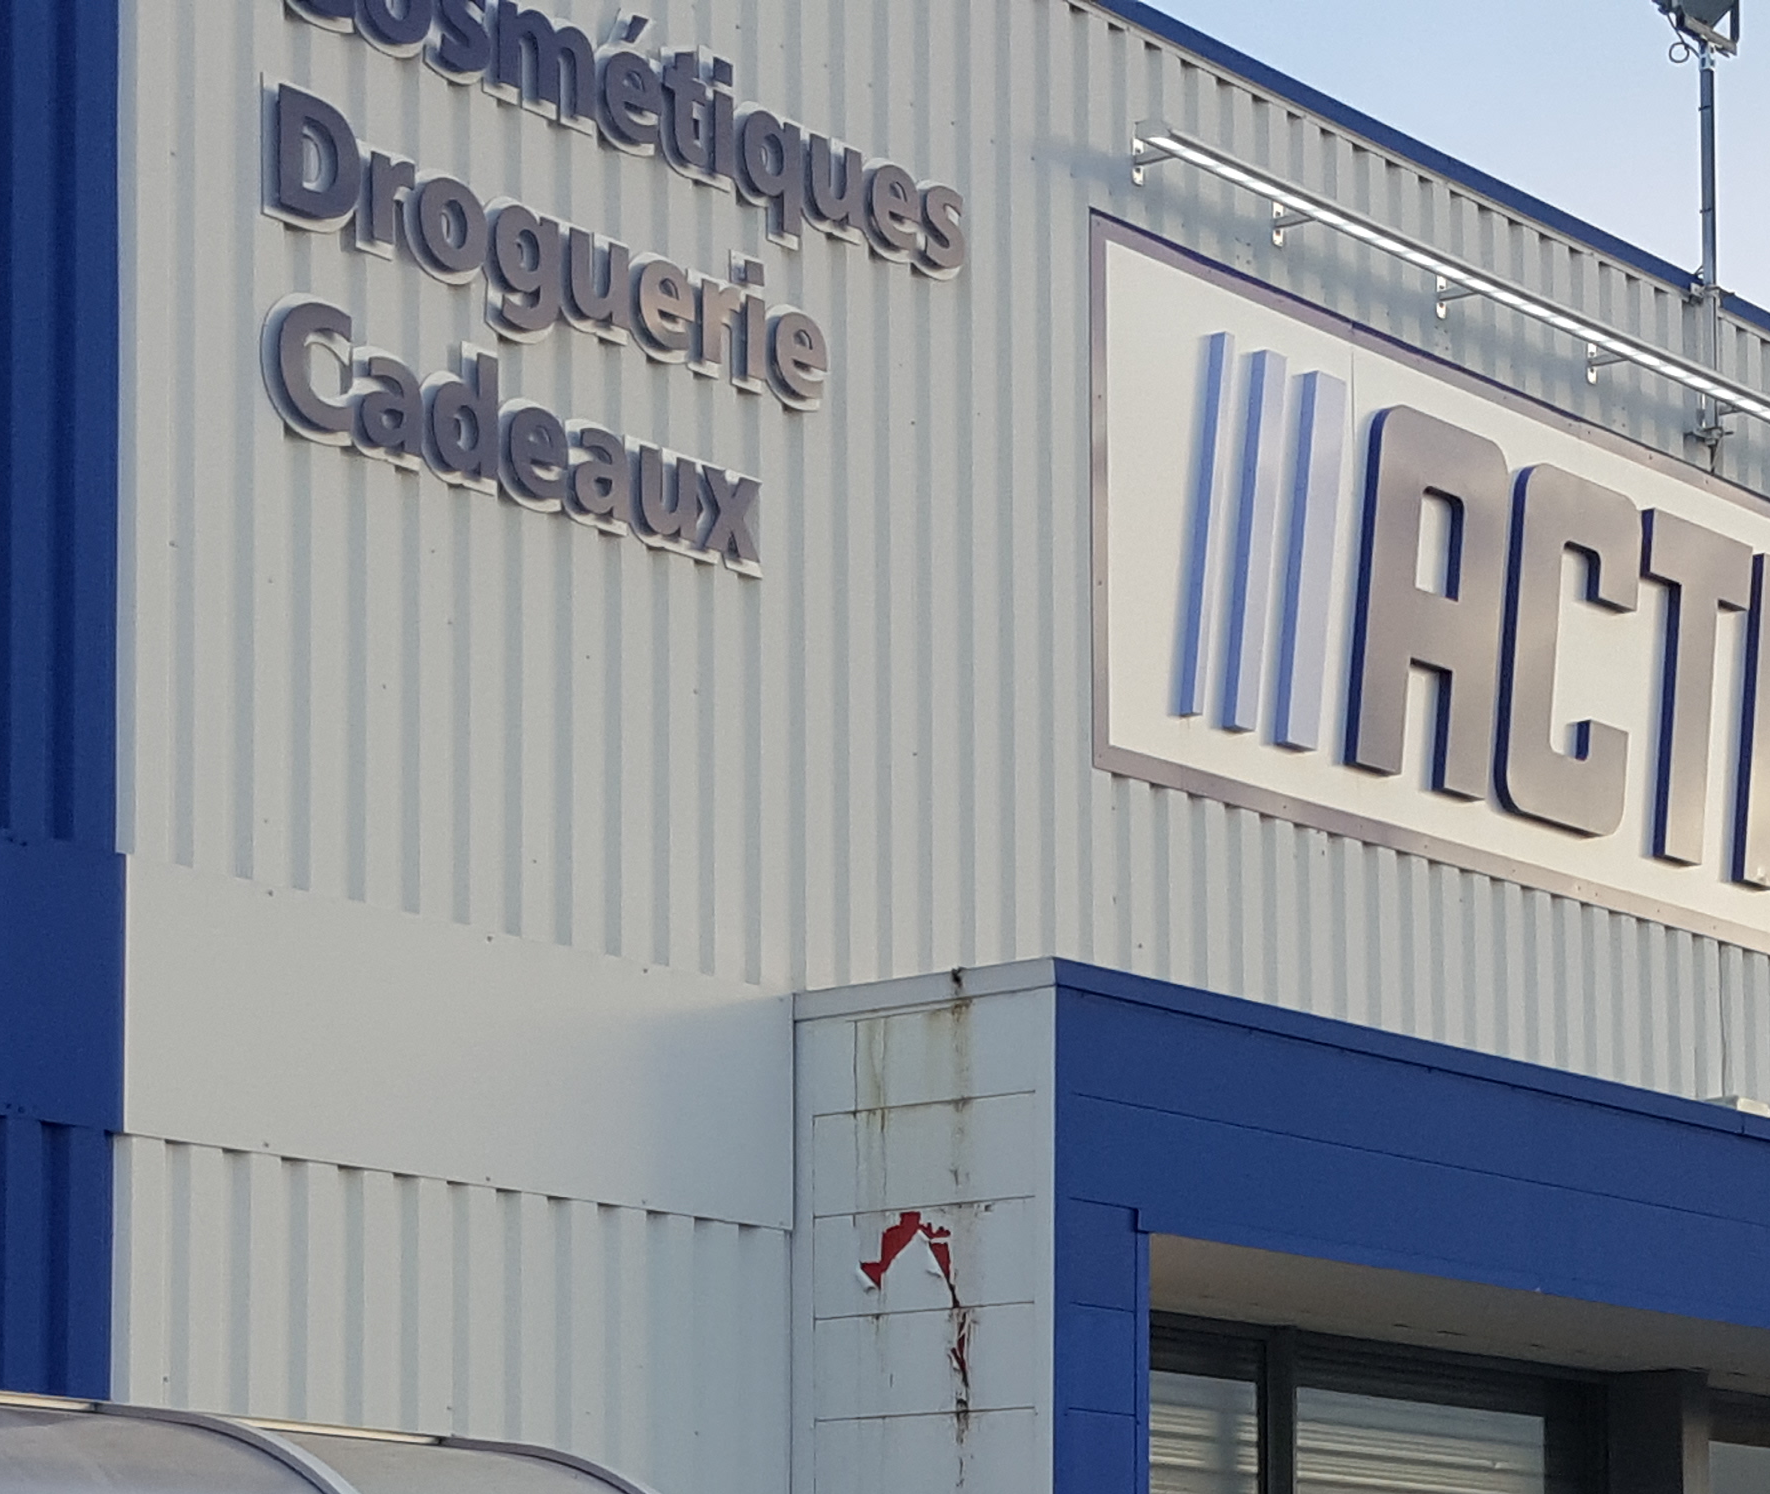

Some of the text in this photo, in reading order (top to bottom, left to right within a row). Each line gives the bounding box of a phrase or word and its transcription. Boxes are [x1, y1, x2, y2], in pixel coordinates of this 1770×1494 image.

[261, 72, 830, 412] Droguerie
[284, 0, 966, 280] smétiques
[261, 292, 763, 578] Cadeaux
